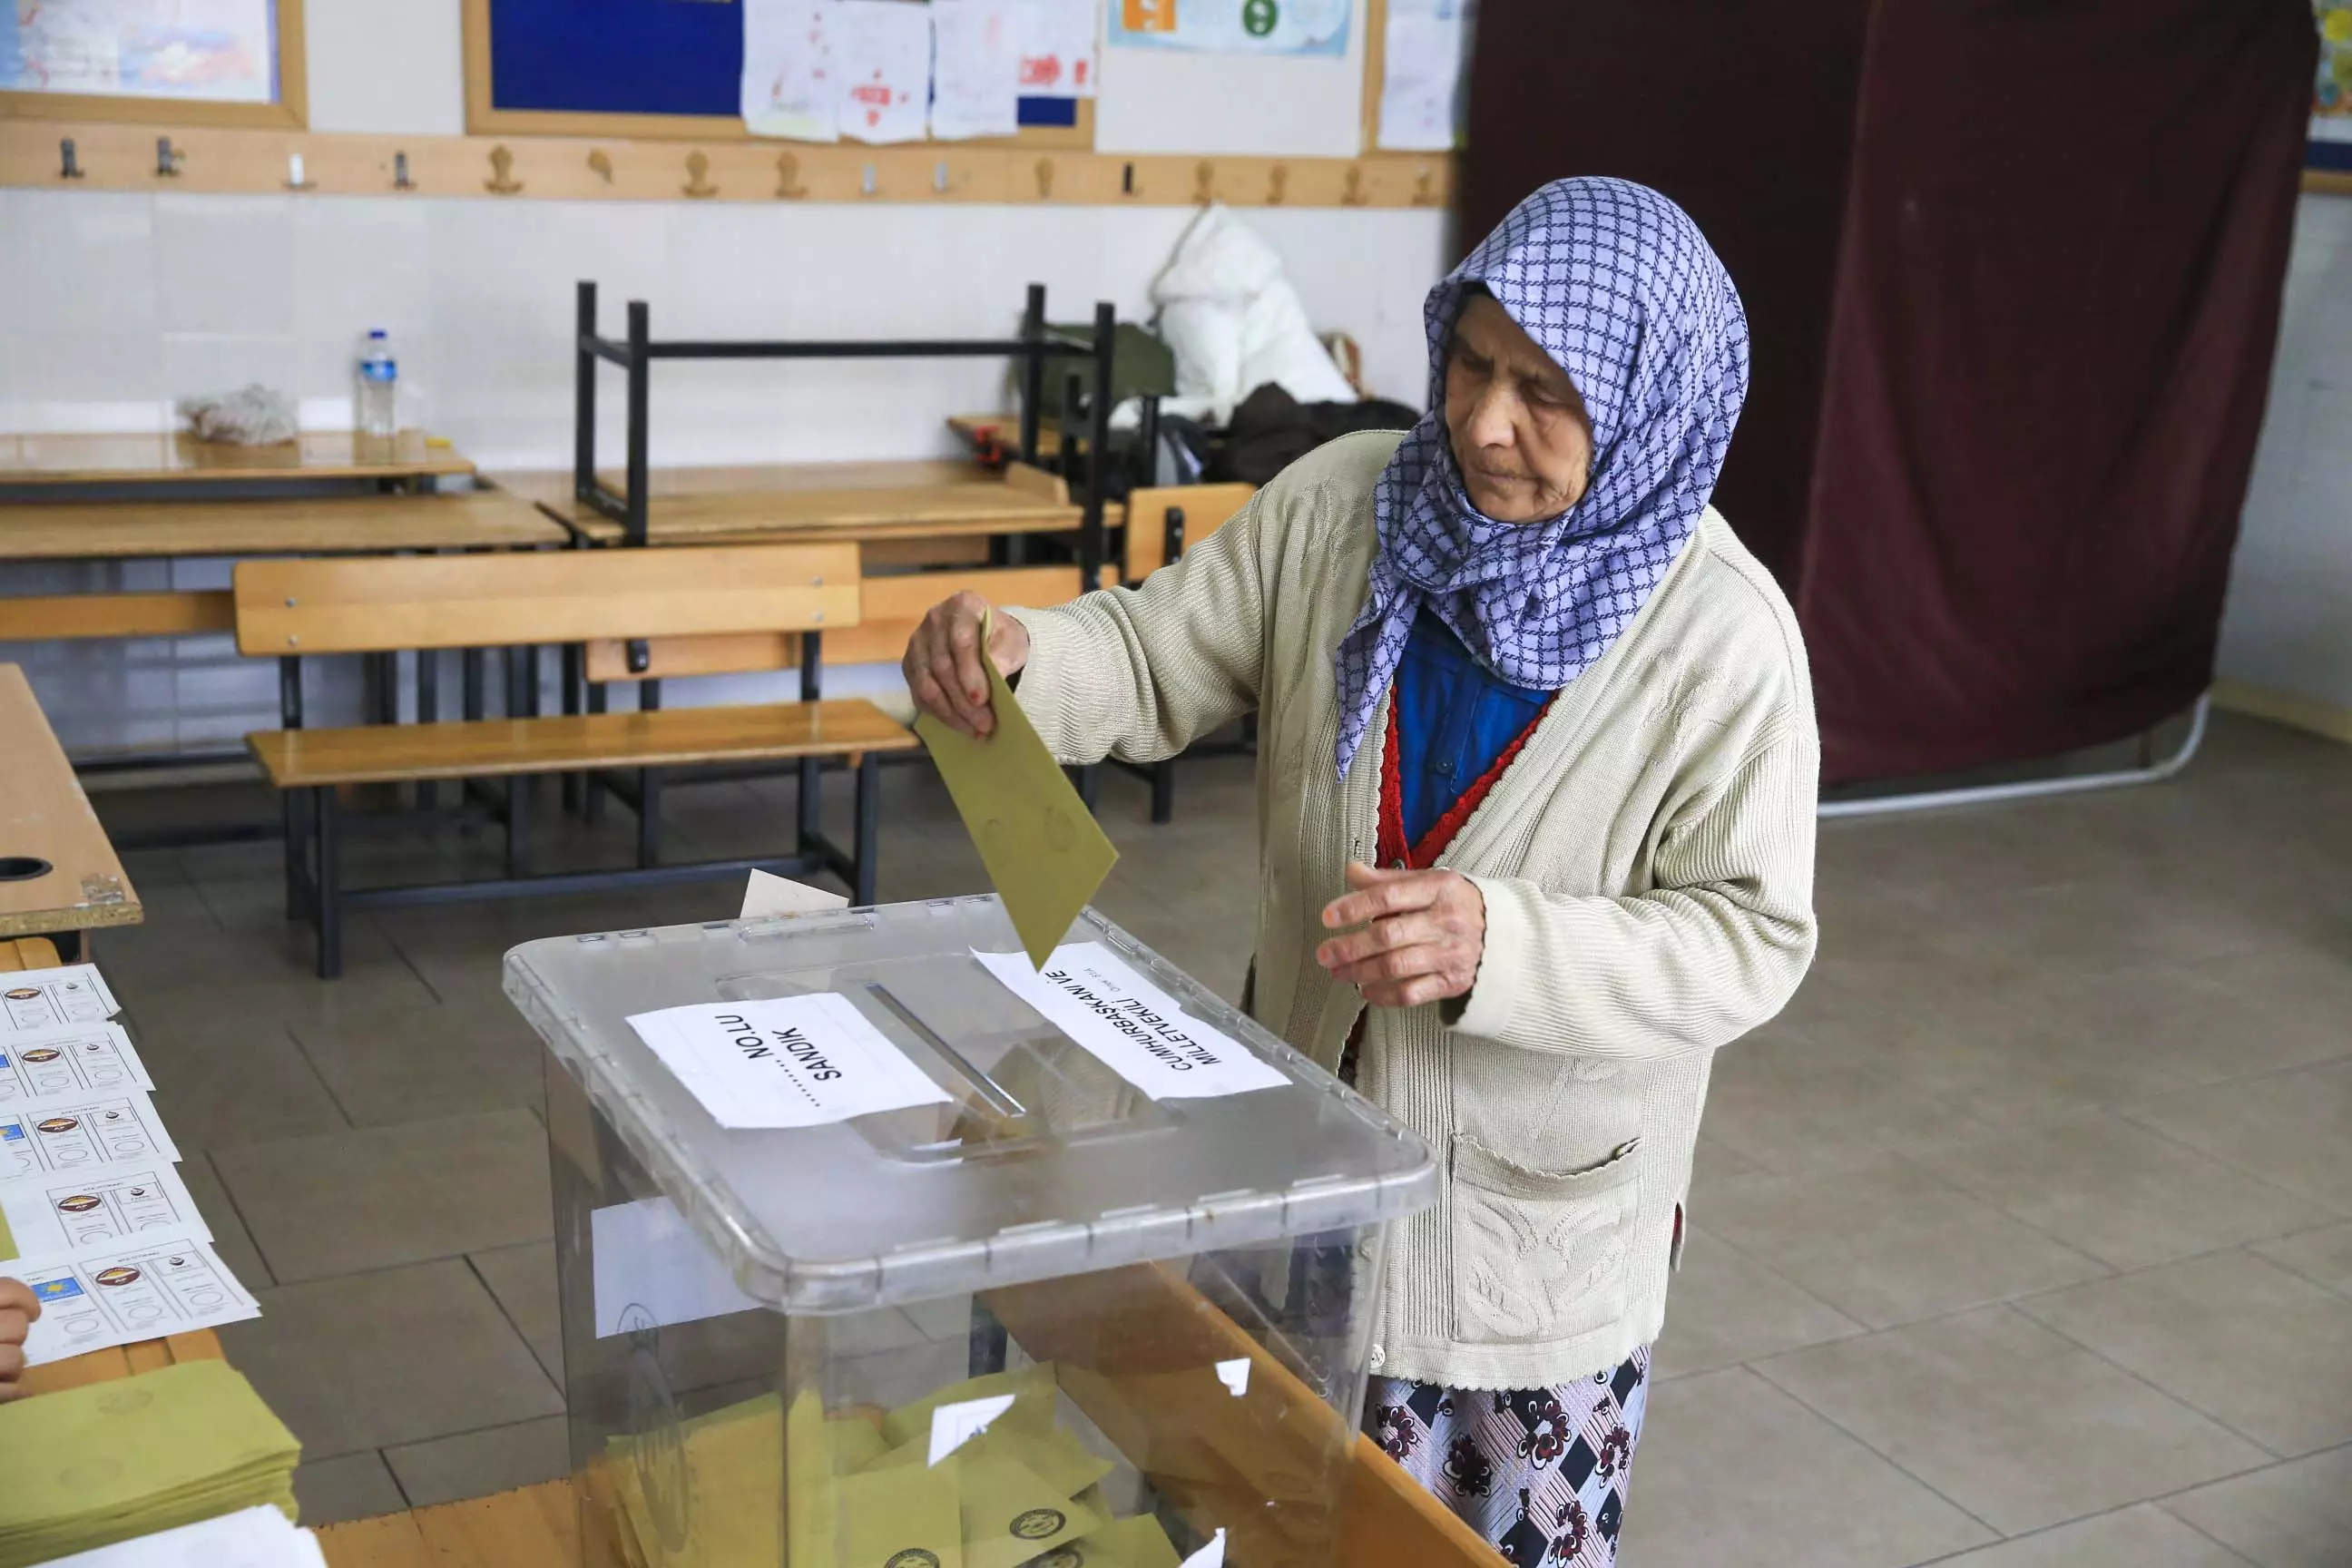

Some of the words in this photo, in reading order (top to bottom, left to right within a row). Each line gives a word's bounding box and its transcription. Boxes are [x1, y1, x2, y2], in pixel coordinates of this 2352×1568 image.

[771, 1026, 842, 1081] SANDIK
[1063, 985, 1192, 1071] CUMHURBAŞKANI
[1112, 998, 1222, 1064] MİLLETVEKİLİ
